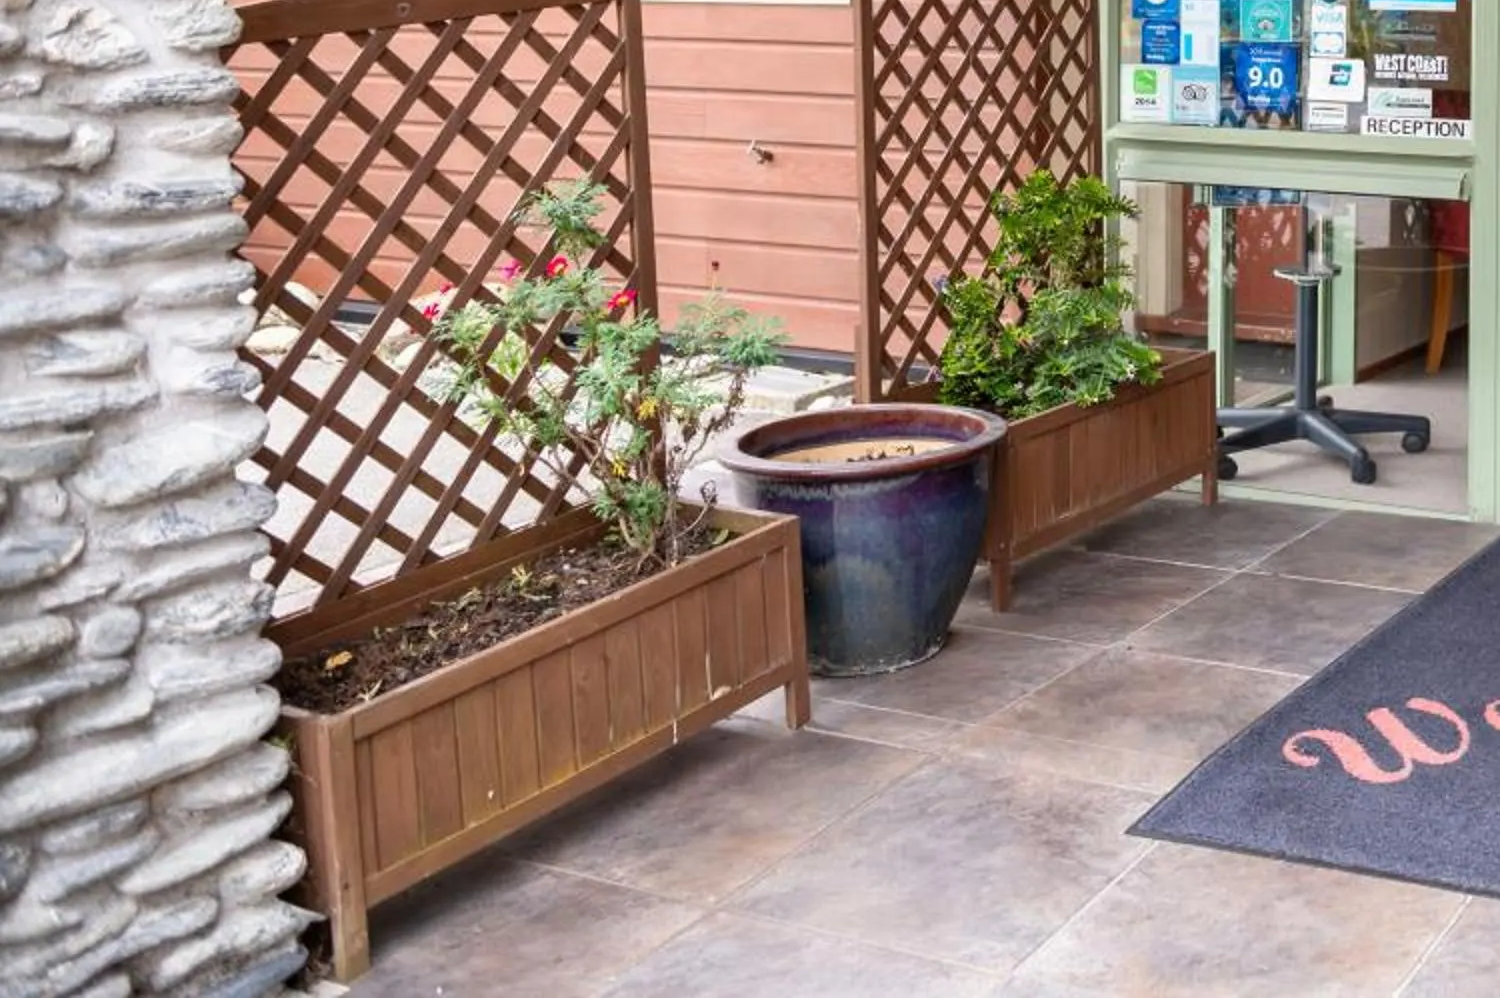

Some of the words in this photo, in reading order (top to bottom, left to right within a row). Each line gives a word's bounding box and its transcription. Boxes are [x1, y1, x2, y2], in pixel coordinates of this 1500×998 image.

[1373, 53, 1407, 72] WEST
[1247, 65, 1284, 89] 9.0
[1367, 118, 1465, 137] RECEPTION
